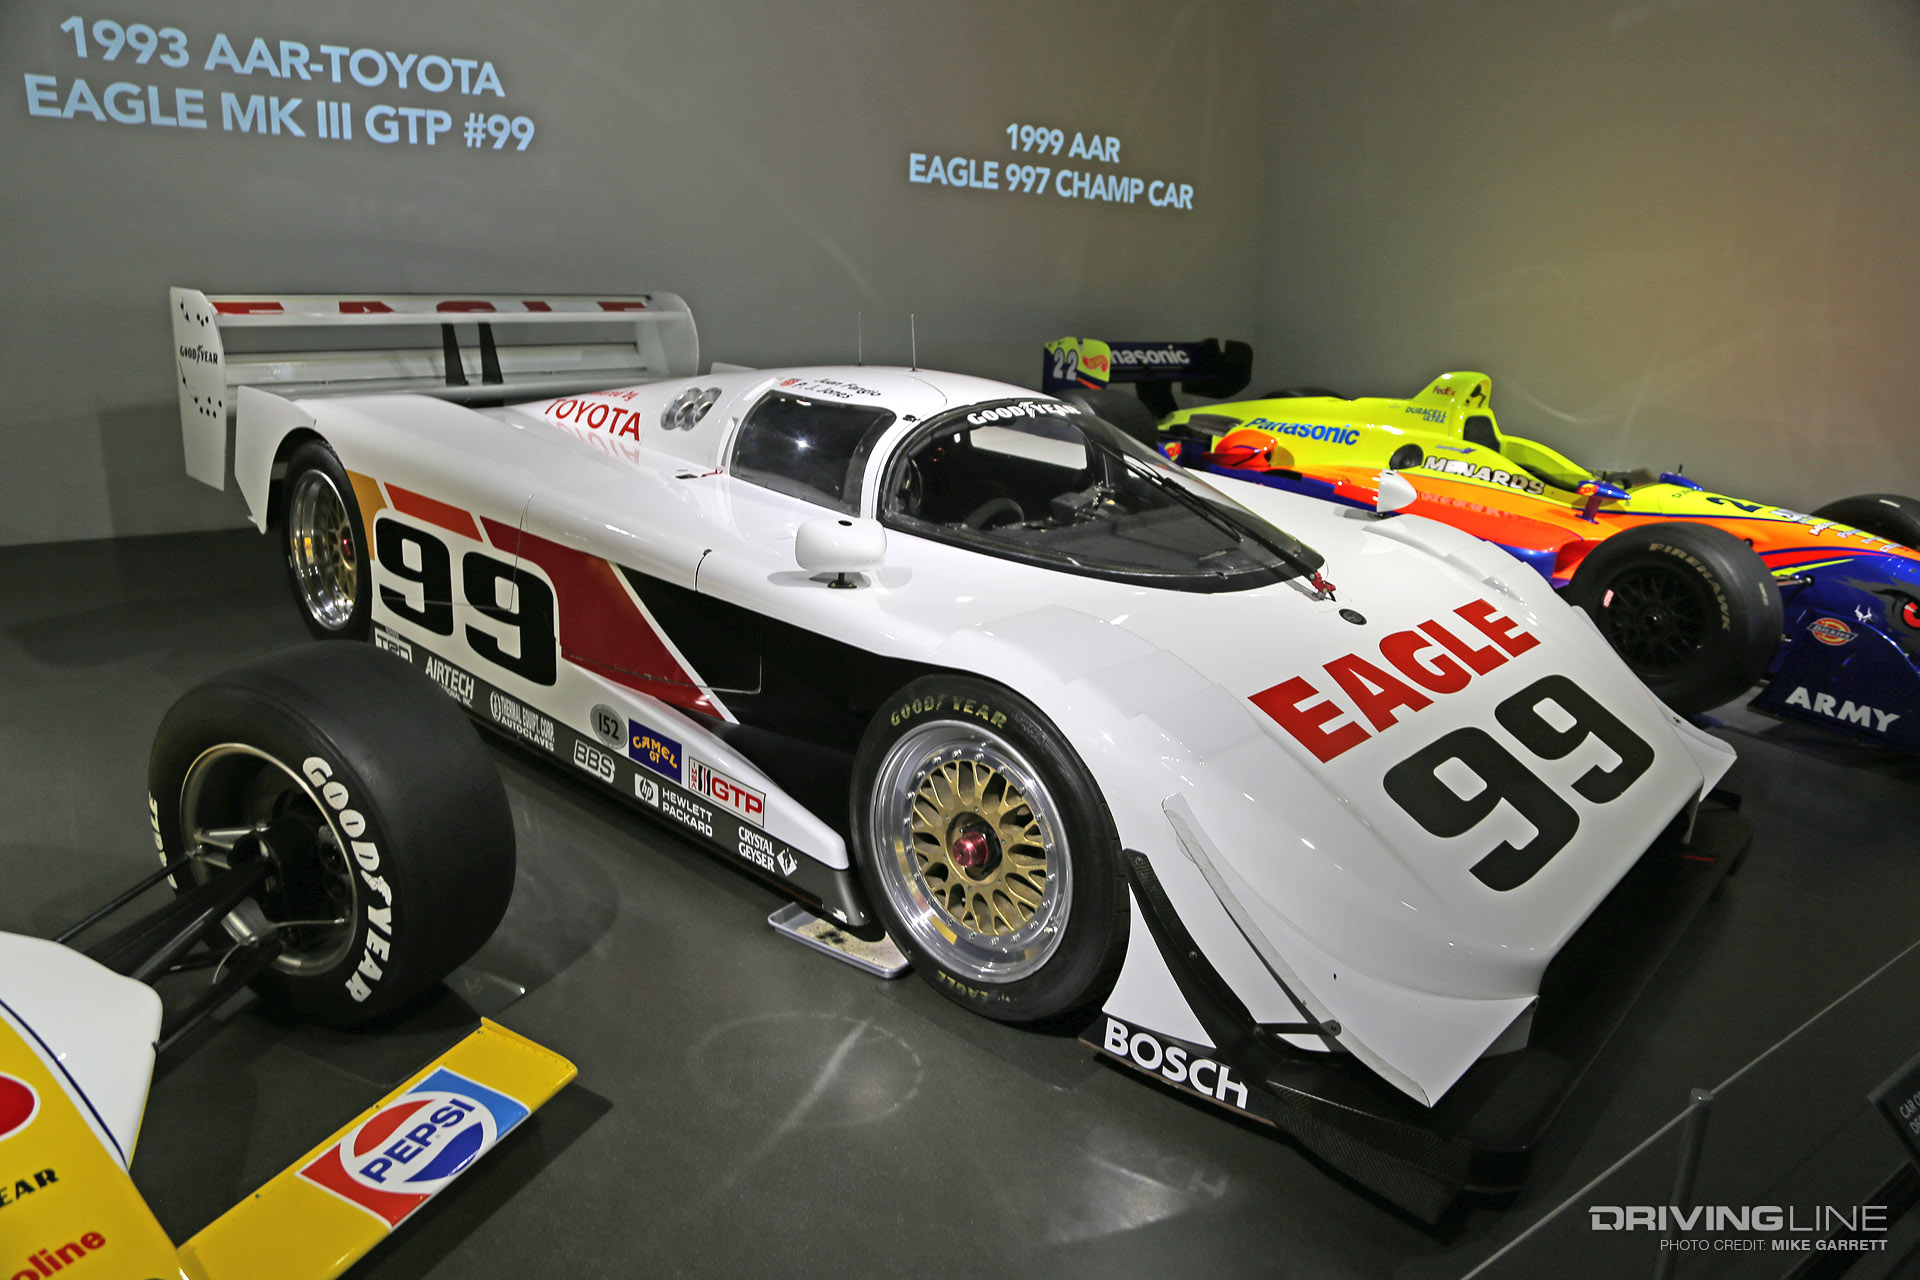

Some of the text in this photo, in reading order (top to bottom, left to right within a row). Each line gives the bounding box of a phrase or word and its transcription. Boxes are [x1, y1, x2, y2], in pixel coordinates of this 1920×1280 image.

[60, 16, 506, 98] 1993 AAR-TOYOTA
[24, 73, 535, 151] EAGLE MK III GTP #99
[1006, 123, 1120, 163] 1999 AAR
[909, 153, 1194, 209] EAGLE 997 CHAMP CAR
[1053, 347, 1078, 381] 22
[1432, 385, 1457, 397] FedEx
[545, 398, 641, 442] TOYOTA
[1244, 417, 1360, 446] Panasonic
[1405, 406, 1447, 419] DURACELL
[1423, 456, 1545, 495] MENARDS
[374, 516, 557, 686] 99
[1649, 543, 1731, 632] FIREHAWK
[426, 656, 474, 700] AIRTECH
[1247, 598, 1541, 764] EAGLE
[501, 695, 522, 725] THERMAL
[598, 713, 619, 740] 152
[1785, 686, 1901, 732] ARMY
[501, 715, 555, 752] AUTOCLAVES
[632, 736, 677, 769] CAMEL
[573, 739, 615, 783] BBS
[649, 751, 660, 764] GT
[642, 777, 654, 801] hp
[711, 776, 762, 814] GTP
[1383, 674, 1655, 892] 99
[662, 787, 712, 822] HEWLETT
[662, 803, 713, 837] PACKARD
[738, 826, 774, 856] CRYSTAL
[738, 842, 775, 872] GEYSER
[1104, 1017, 1248, 1109] BOSCH
[359, 1097, 476, 1183] PEPSI
